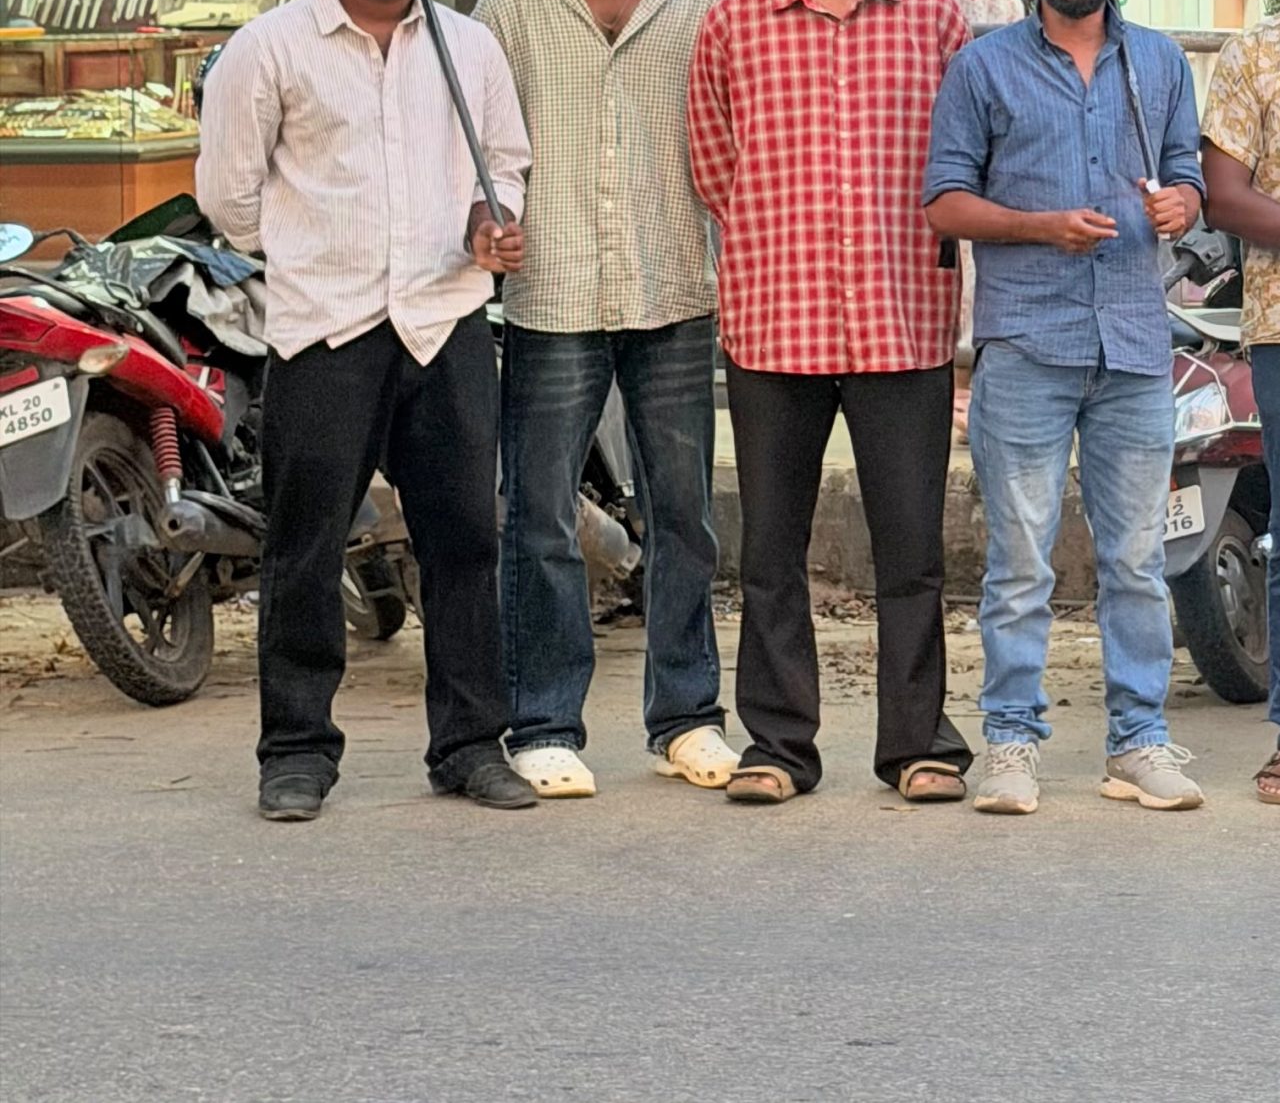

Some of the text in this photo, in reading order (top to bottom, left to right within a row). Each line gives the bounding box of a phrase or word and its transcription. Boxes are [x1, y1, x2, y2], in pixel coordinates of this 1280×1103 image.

[22, 395, 41, 411] 20
[4, 407, 53, 434] 4850
[1166, 503, 1185, 519] 2
